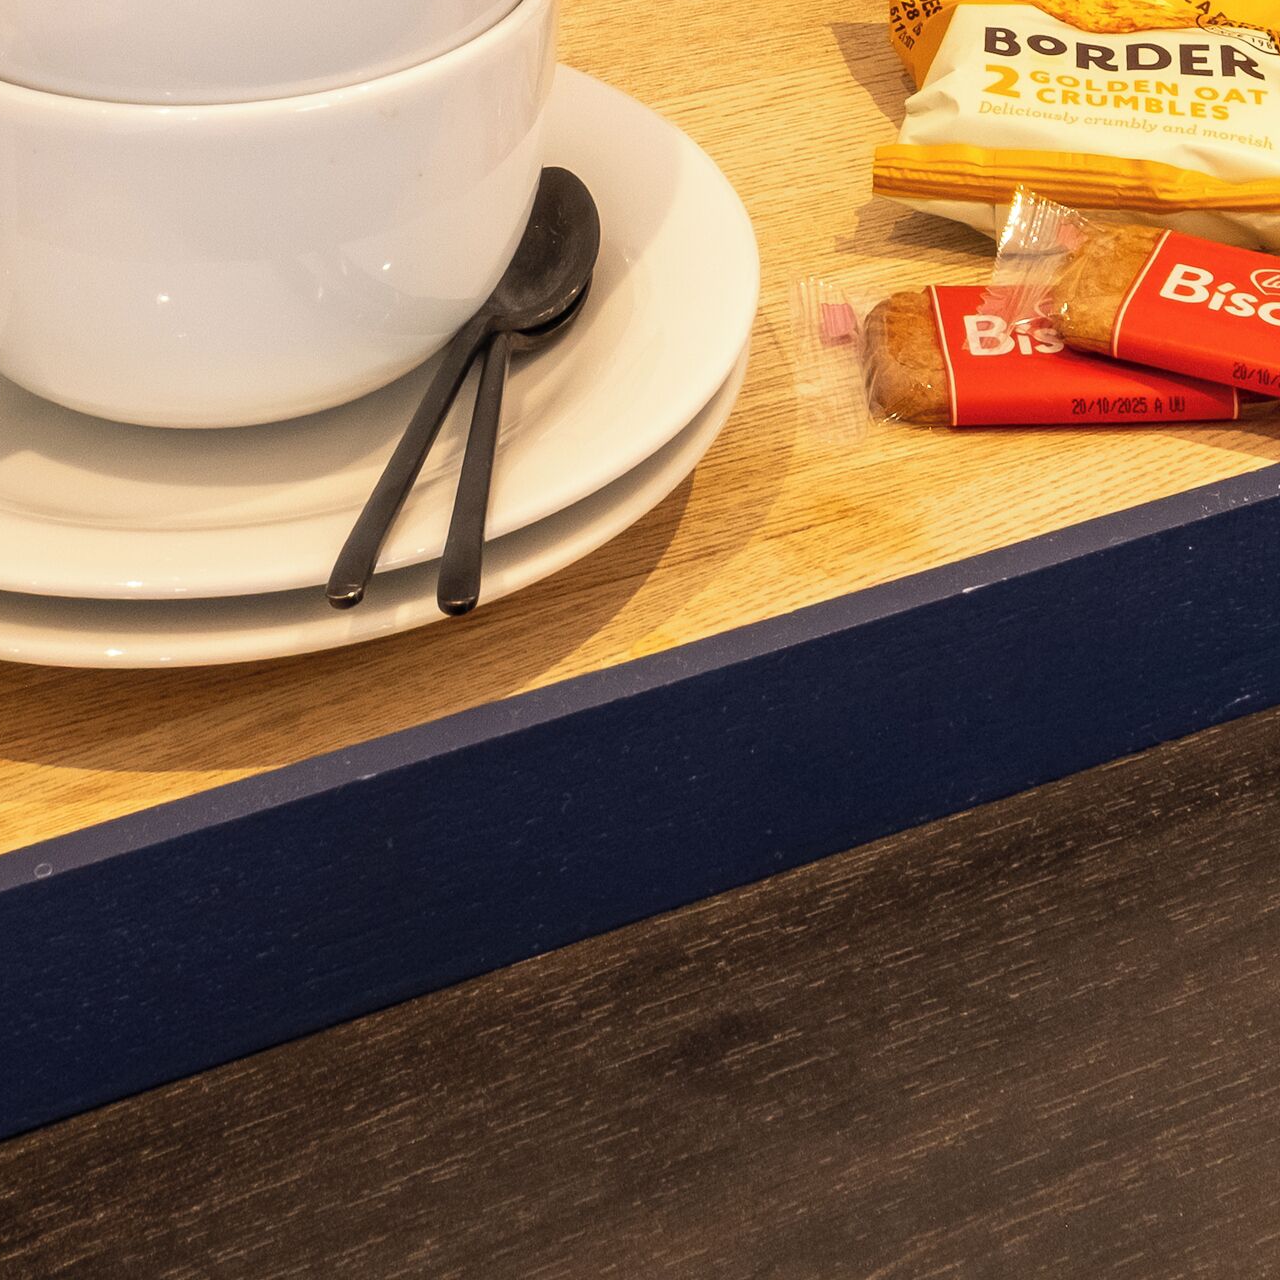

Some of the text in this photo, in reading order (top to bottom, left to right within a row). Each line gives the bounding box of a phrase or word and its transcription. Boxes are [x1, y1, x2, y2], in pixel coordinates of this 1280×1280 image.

[983, 26, 1266, 81] BORDER
[982, 63, 1269, 105] 2 GOLDEN OAT
[1036, 87, 1230, 121] CRUMBLES
[978, 100, 1273, 151] Deliciously crumbly and moreish
[1071, 396, 1148, 415] 20/10/2025
